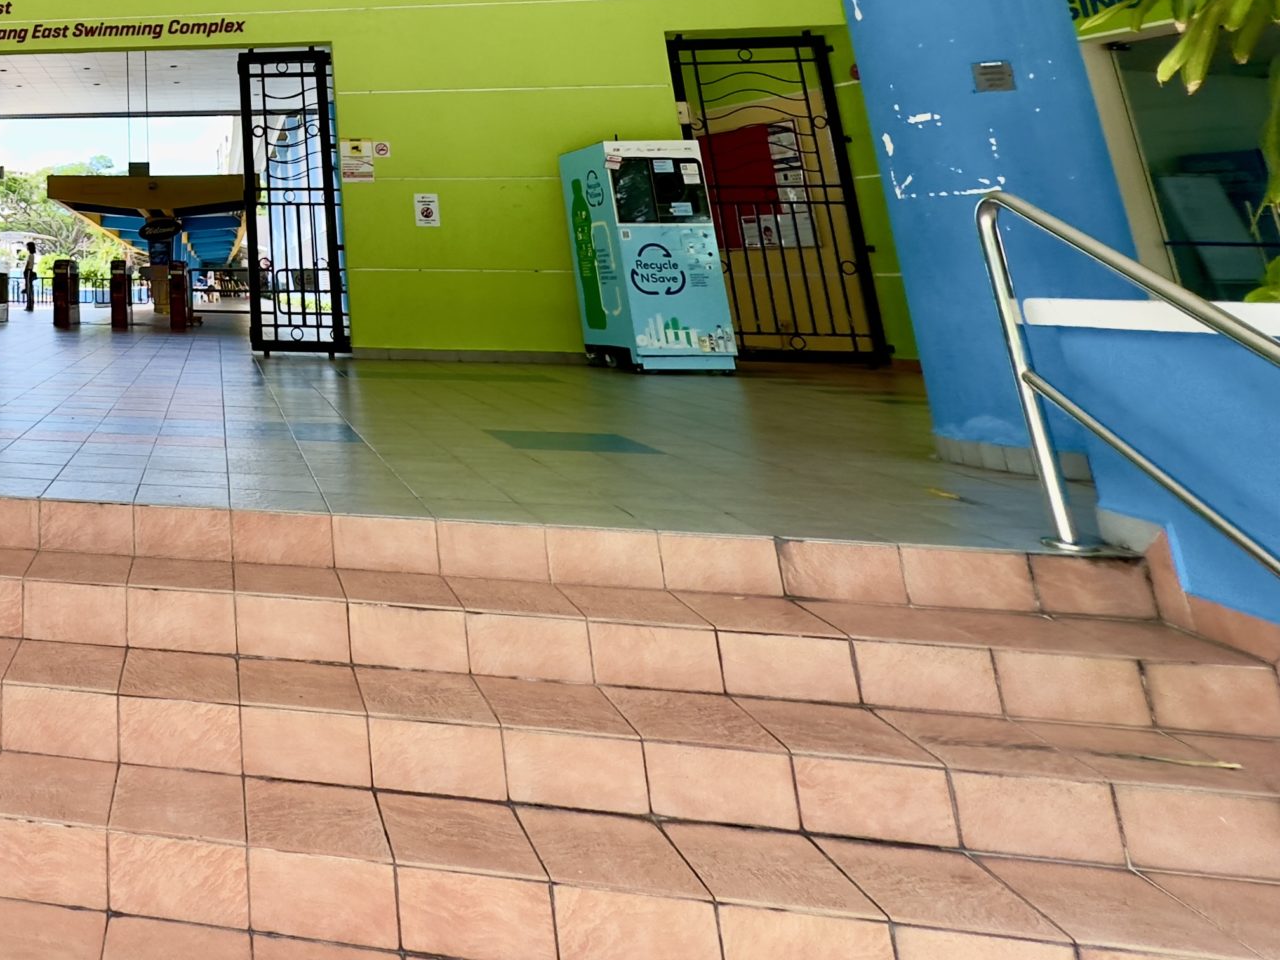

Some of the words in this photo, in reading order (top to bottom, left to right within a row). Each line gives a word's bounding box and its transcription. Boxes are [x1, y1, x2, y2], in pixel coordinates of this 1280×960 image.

[32, 24, 69, 39] East
[72, 22, 164, 39] Swimming
[168, 18, 246, 38] Complex
[635, 259, 679, 272] Recycle
